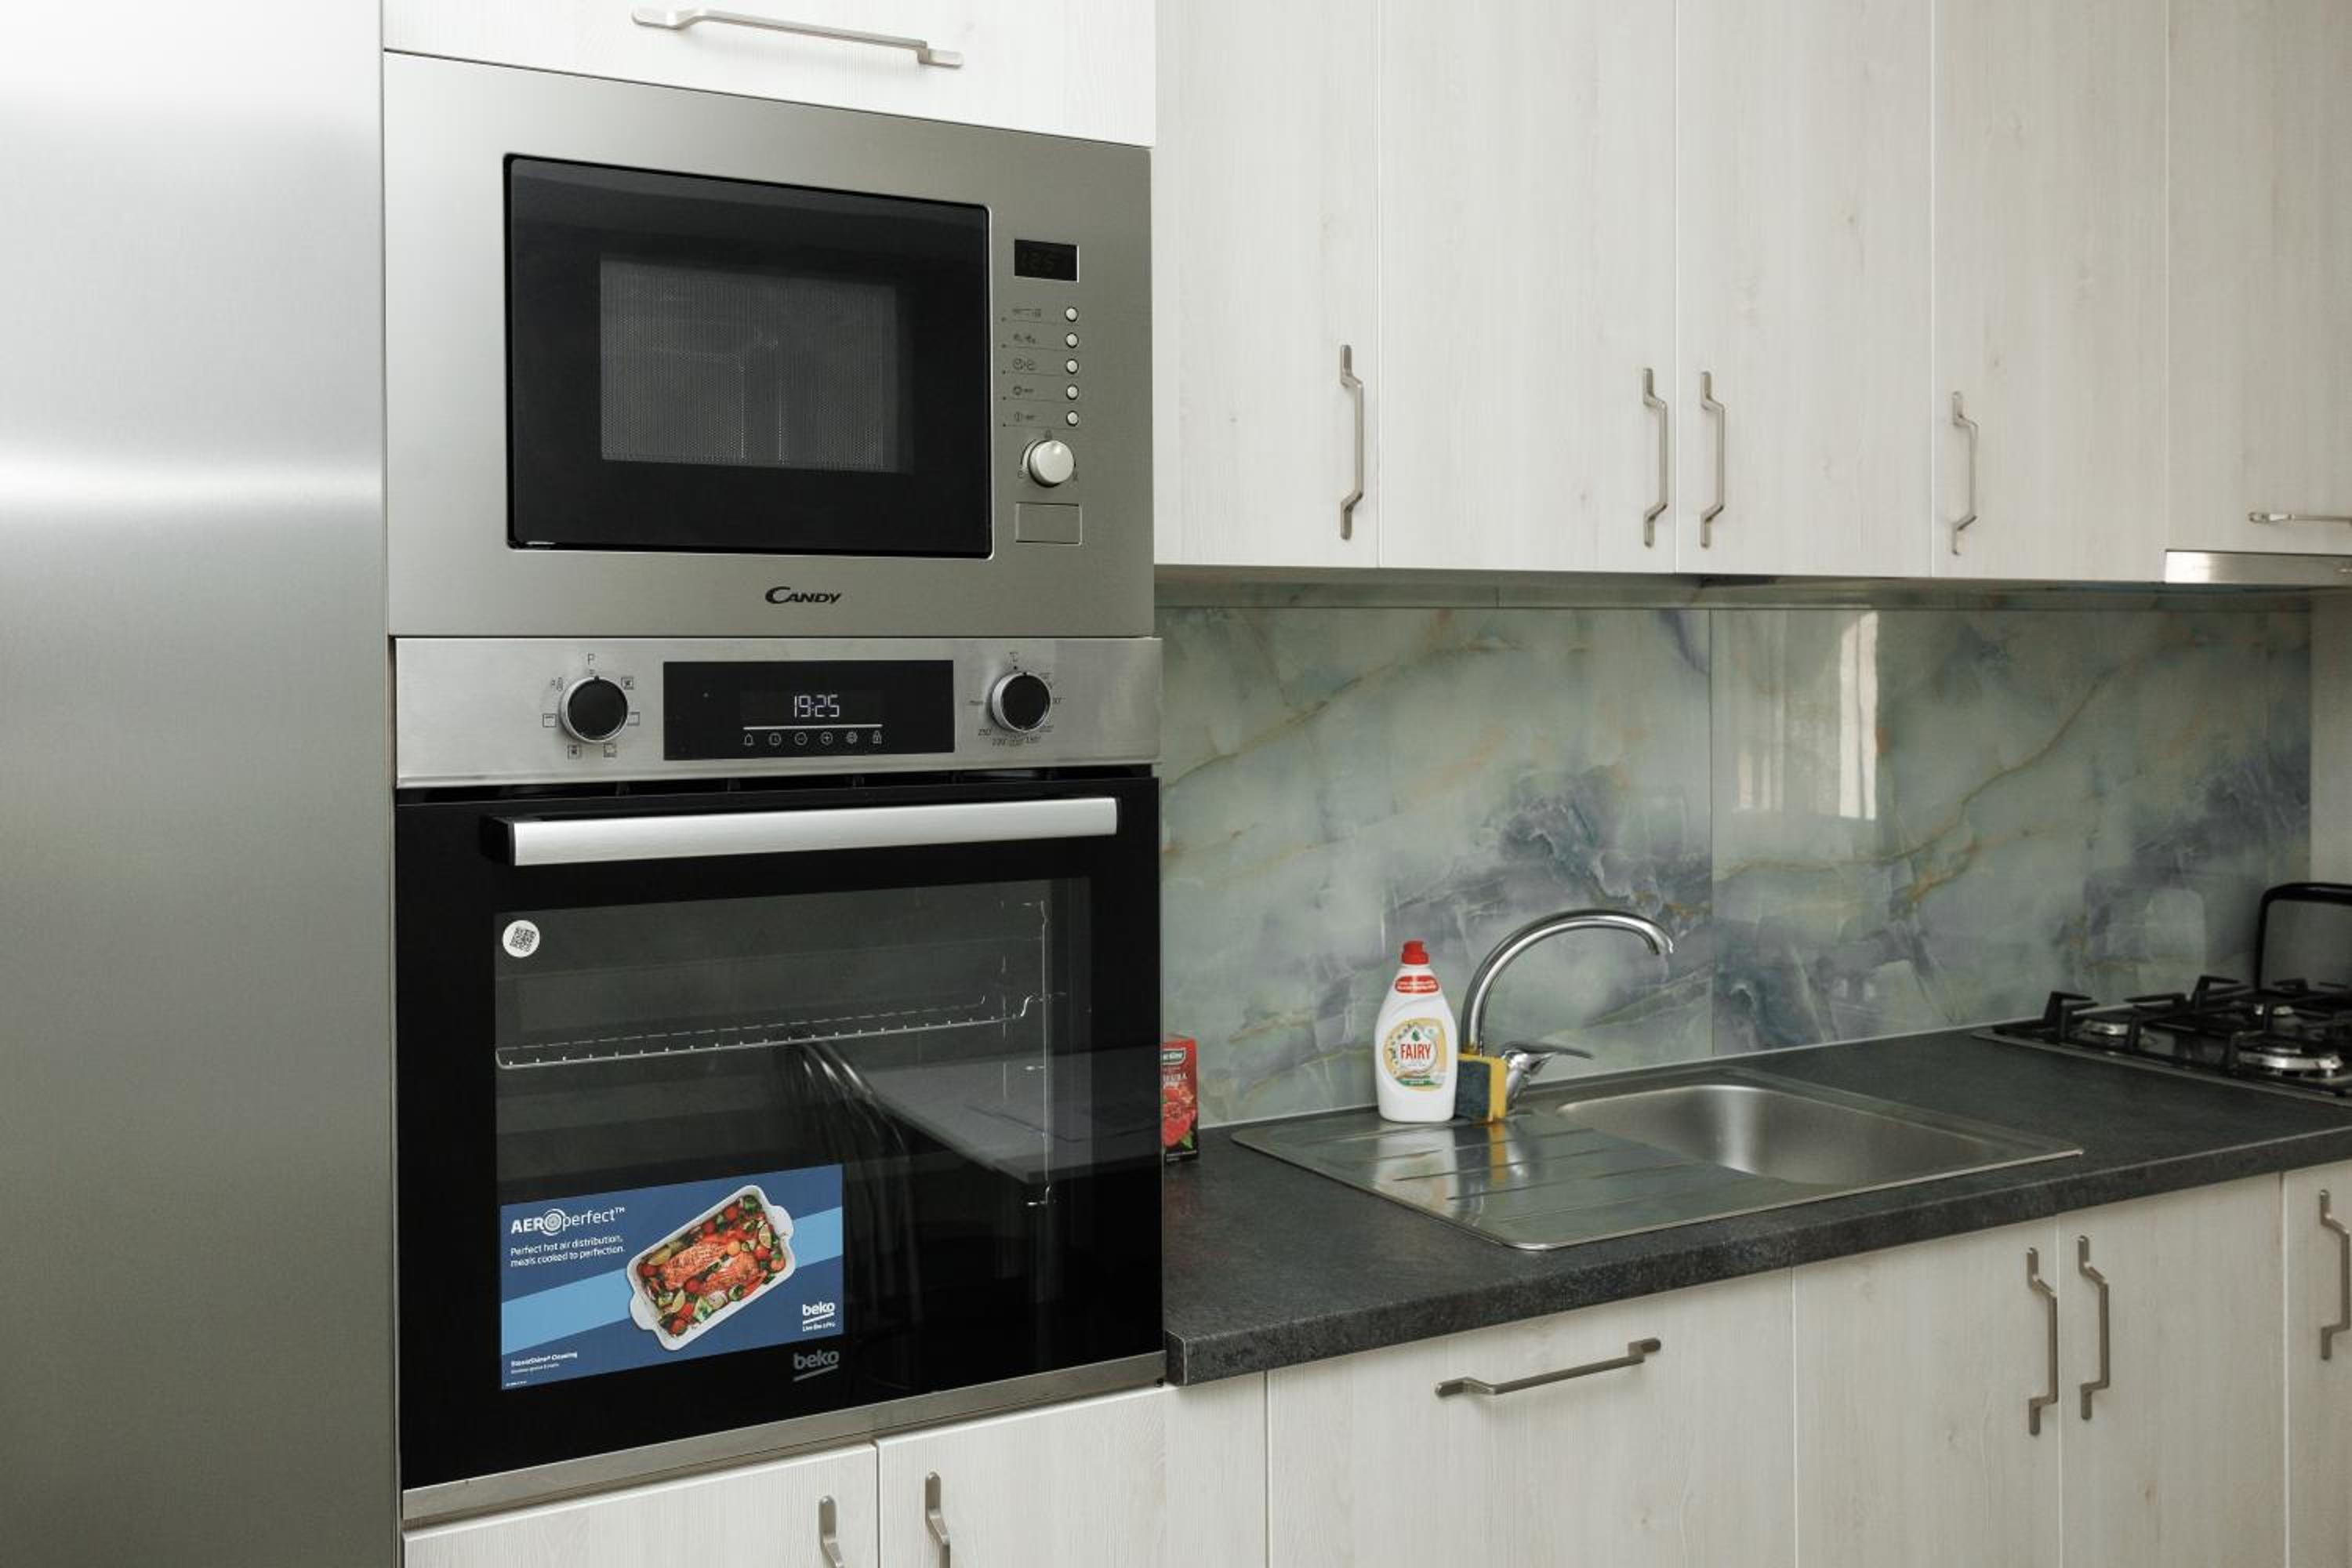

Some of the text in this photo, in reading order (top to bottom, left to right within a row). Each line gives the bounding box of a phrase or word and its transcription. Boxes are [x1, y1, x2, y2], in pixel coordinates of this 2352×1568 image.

[765, 586, 841, 604] CANDY
[793, 694, 840, 718] 19:25
[1400, 1044, 1431, 1060] FAIRY
[510, 1244, 542, 1256] Perfect
[543, 1242, 558, 1252] hot
[559, 1241, 571, 1250] air
[510, 1257, 535, 1268] meals
[537, 1252, 568, 1263] cooked
[802, 1301, 835, 1316] beko
[793, 1349, 840, 1370] beko
